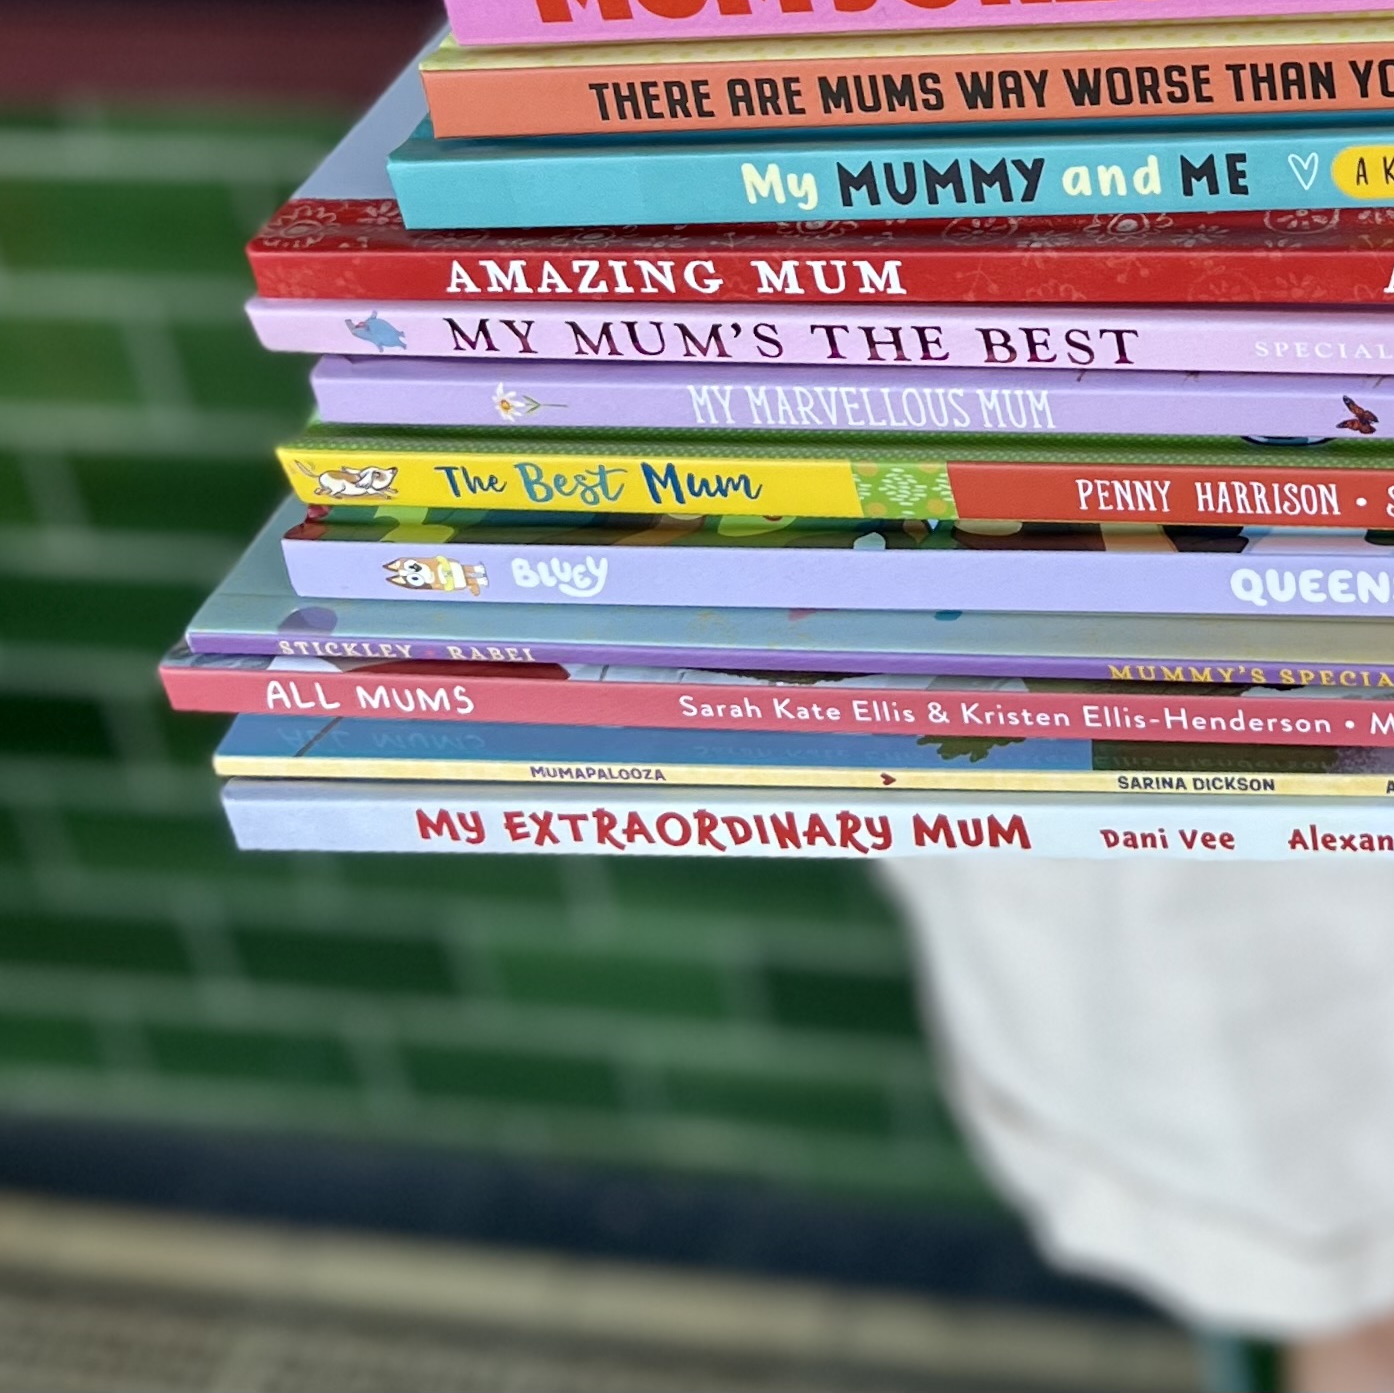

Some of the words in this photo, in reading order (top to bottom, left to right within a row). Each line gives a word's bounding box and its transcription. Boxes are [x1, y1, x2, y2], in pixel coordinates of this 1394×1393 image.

[589, 79, 716, 121] THERE
[727, 76, 806, 117] ARE
[817, 71, 945, 114] MUMS
[955, 69, 1049, 110] WAY
[1063, 63, 1214, 107] WORSE
[1225, 61, 1337, 103] THAN
[740, 162, 819, 211] My
[836, 157, 1045, 207] MUMMY
[1062, 154, 1162, 197] and
[1179, 152, 1249, 198] ME
[1355, 157, 1369, 186] A
[446, 259, 724, 294] AMAZING
[751, 260, 907, 295] MUM
[443, 317, 538, 354] MY
[810, 324, 950, 362] THE
[975, 327, 1139, 366] BEST
[1254, 340, 1394, 361] SPECIAL
[687, 384, 736, 425] MY
[745, 386, 971, 428] MARVELLOUS
[977, 388, 1056, 430] MUM
[434, 465, 507, 498] The
[513, 461, 629, 506] Best
[640, 461, 763, 504] Mum
[1075, 479, 1171, 513] PENNY
[1195, 481, 1341, 517] HARRISON
[278, 640, 413, 658] STICKLEY
[447, 646, 535, 662] RABEI
[266, 680, 341, 710] ALL
[356, 685, 475, 715] MUMS
[679, 695, 762, 720] Sarah
[773, 697, 841, 722] Kate
[852, 699, 916, 724] Ellis
[927, 701, 950, 724] &
[961, 702, 1070, 727] Kristen
[1082, 705, 1332, 734] Ellis-Henderson
[530, 765, 666, 782] MUMAPALOOZA
[1117, 775, 1187, 790] SARINA
[1192, 777, 1275, 792] DICKSON
[415, 808, 486, 845] MY
[504, 808, 893, 854] EXTRAORDINARY
[912, 813, 1032, 850] MUM
[1099, 827, 1169, 850] Dani
[1178, 828, 1236, 851] Vee
